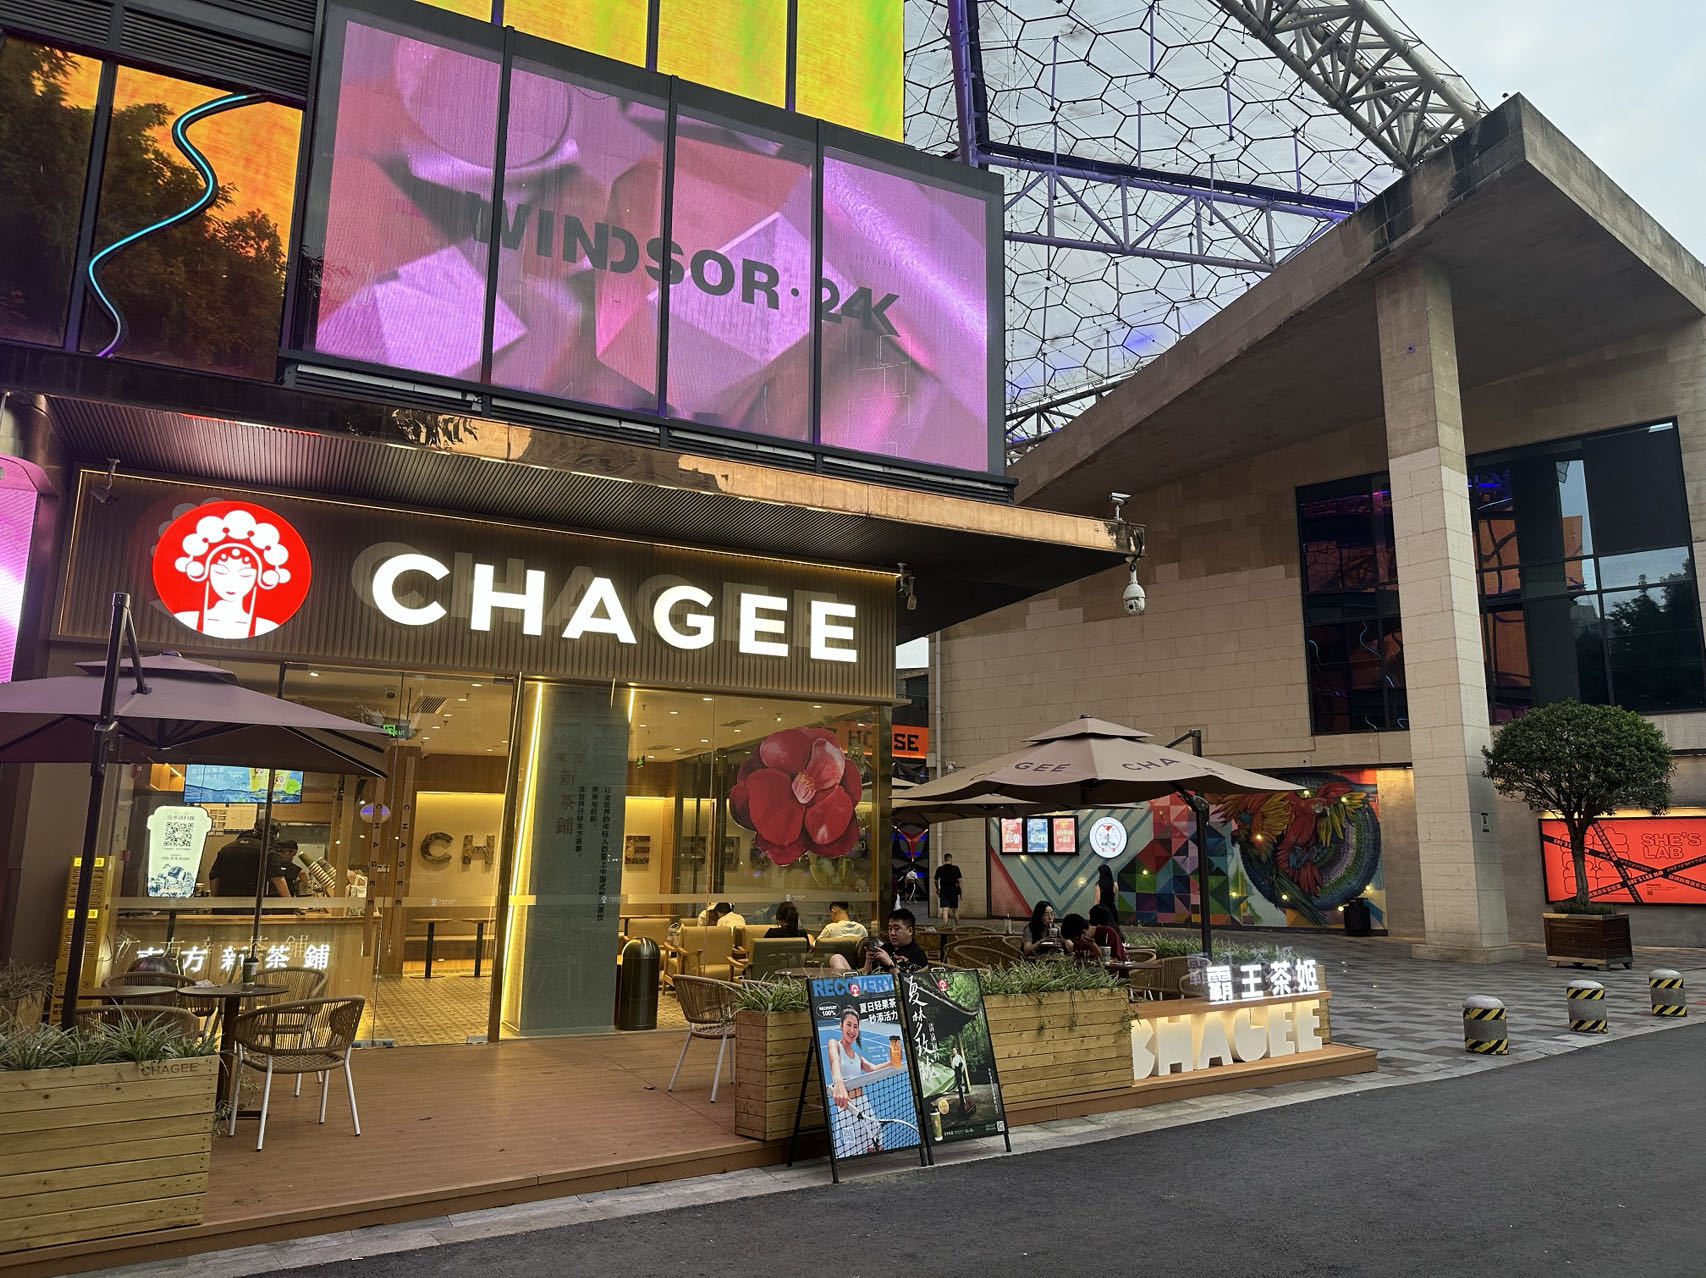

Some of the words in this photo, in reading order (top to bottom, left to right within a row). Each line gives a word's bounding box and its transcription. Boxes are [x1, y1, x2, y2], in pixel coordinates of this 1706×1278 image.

[372, 553, 858, 662] CHAGEE
[1641, 832, 1702, 847] SHE'S
[1643, 846, 1684, 860] LAB
[812, 975, 894, 997] RECOVERY
[1207, 959, 1319, 1002] 霸王茶姬
[859, 998, 896, 1013] 夏日轻果茶
[141, 1062, 199, 1077] CHAGEE
